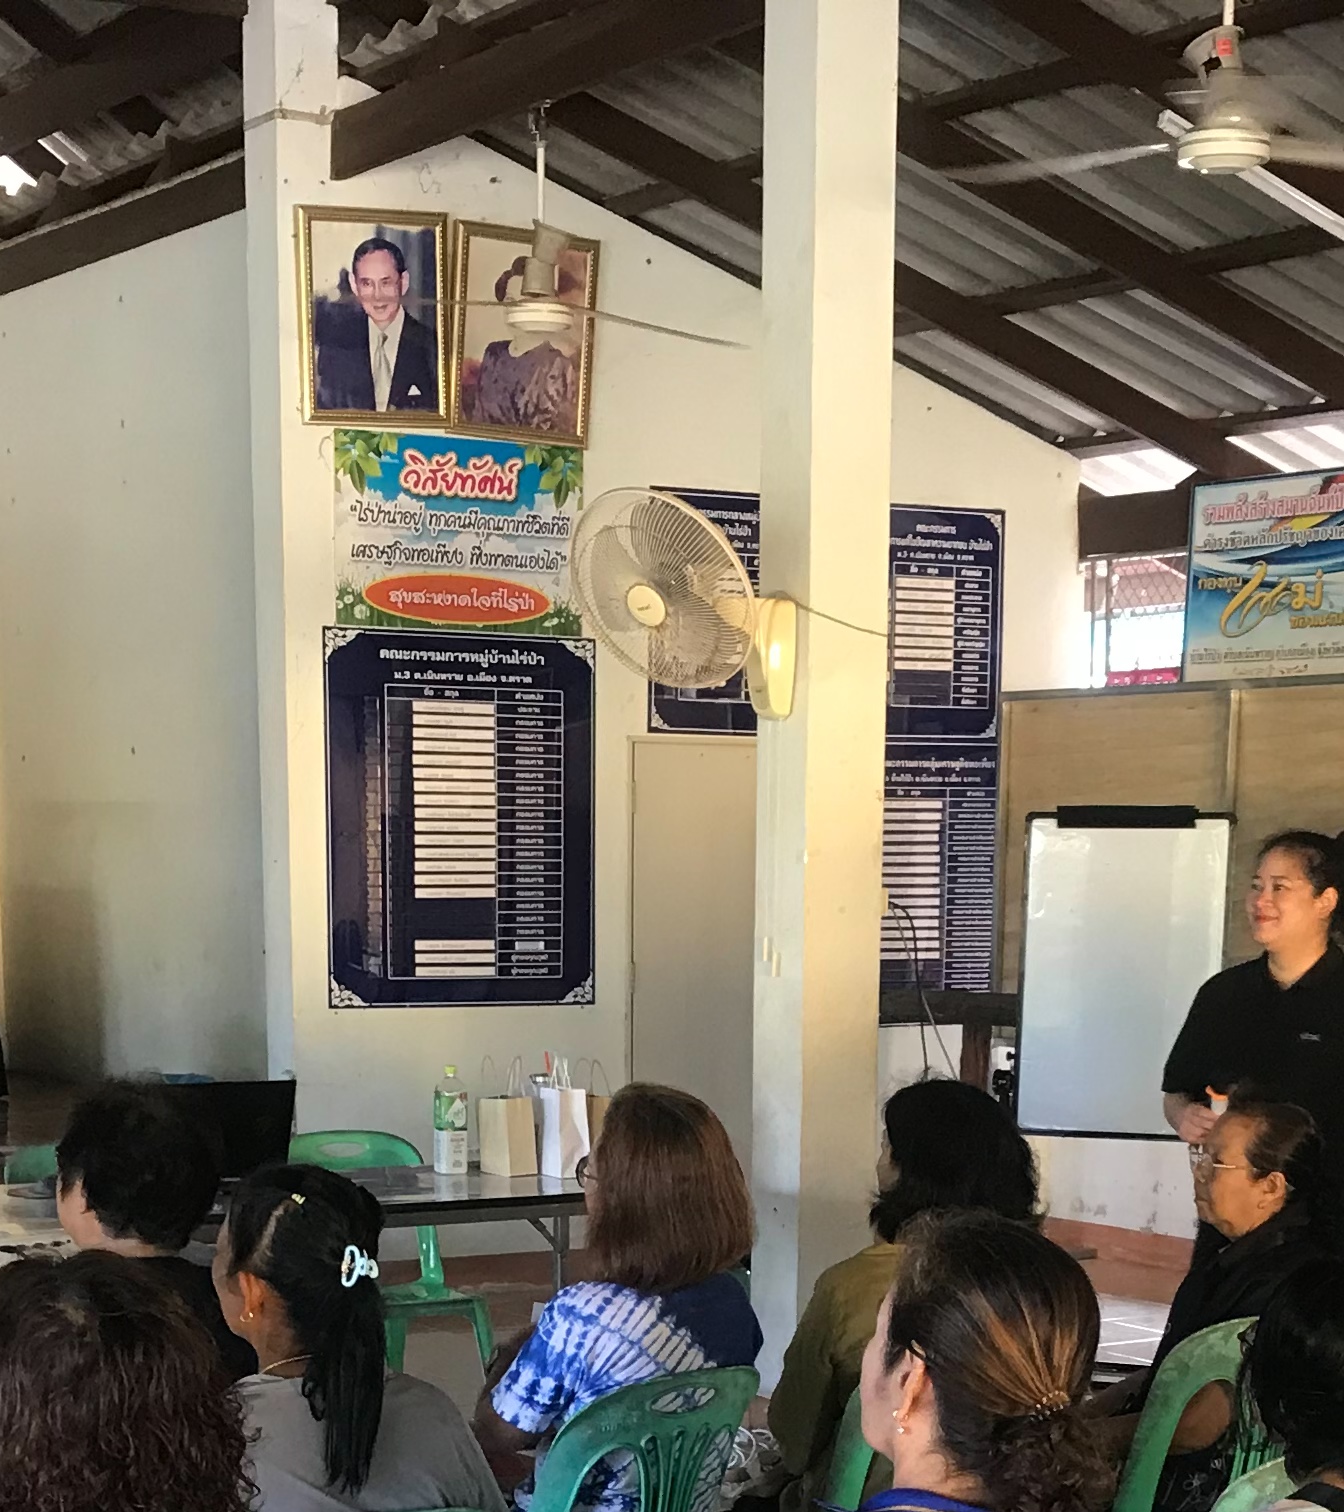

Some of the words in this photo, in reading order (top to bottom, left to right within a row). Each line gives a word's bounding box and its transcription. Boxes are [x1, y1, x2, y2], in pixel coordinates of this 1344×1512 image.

[401, 450, 523, 499] วิสัยทัศน์
[428, 508, 570, 539] ทุกคนมีคุณภาพชีวิตที่ดี
[351, 540, 464, 566] เศรษฐกิจพอเพียง
[379, 648, 545, 668] คณะกรรมการหมู่บ้านไร่ป่า
